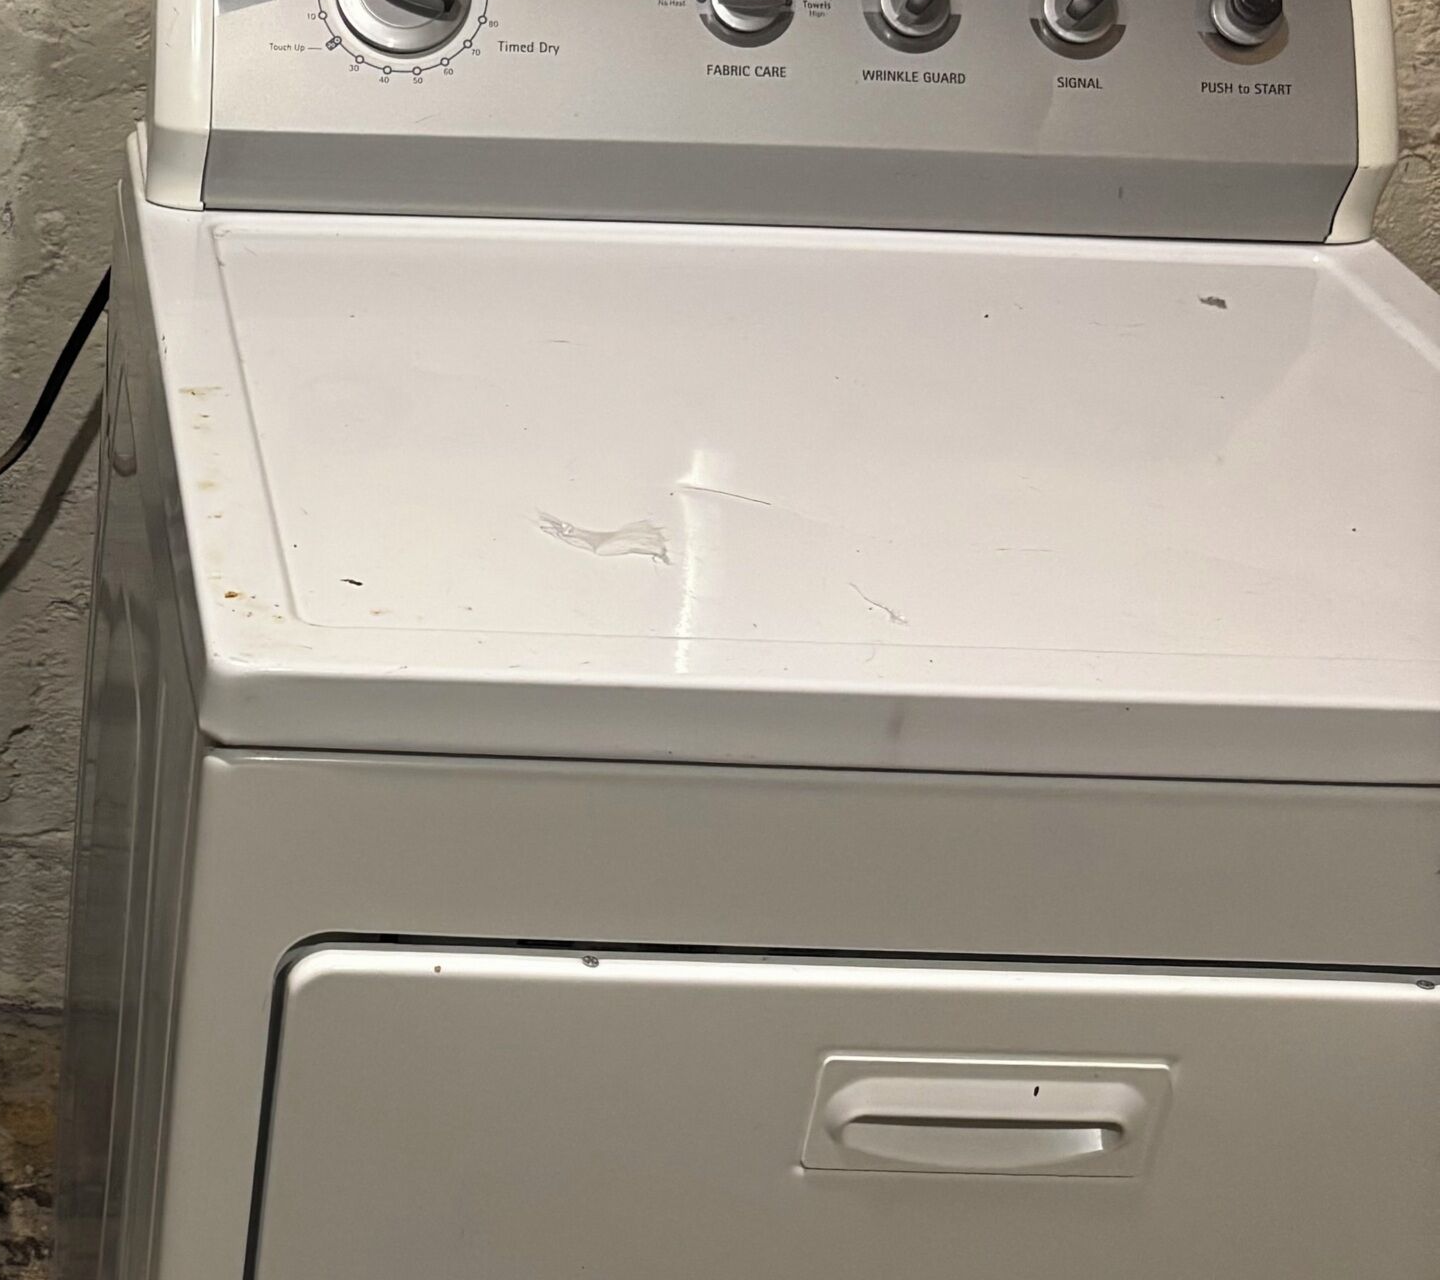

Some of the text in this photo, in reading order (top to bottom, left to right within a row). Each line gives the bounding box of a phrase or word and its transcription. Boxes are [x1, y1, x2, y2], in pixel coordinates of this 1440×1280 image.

[802, 0, 832, 10] Towels
[306, 13, 316, 21] 10
[488, 20, 499, 28] 80
[269, 42, 306, 53] Touch Up
[471, 48, 481, 56] 70
[497, 40, 560, 56] Timed Dry
[348, 64, 360, 72] 30
[443, 67, 454, 76] 60
[706, 63, 788, 79] FABRIC CARE
[378, 76, 390, 84] 40
[412, 77, 423, 85] 50
[862, 69, 966, 85] WRINKLE GUARD
[1057, 76, 1103, 90] SIGNAL
[1200, 81, 1293, 96] PUSH to START
